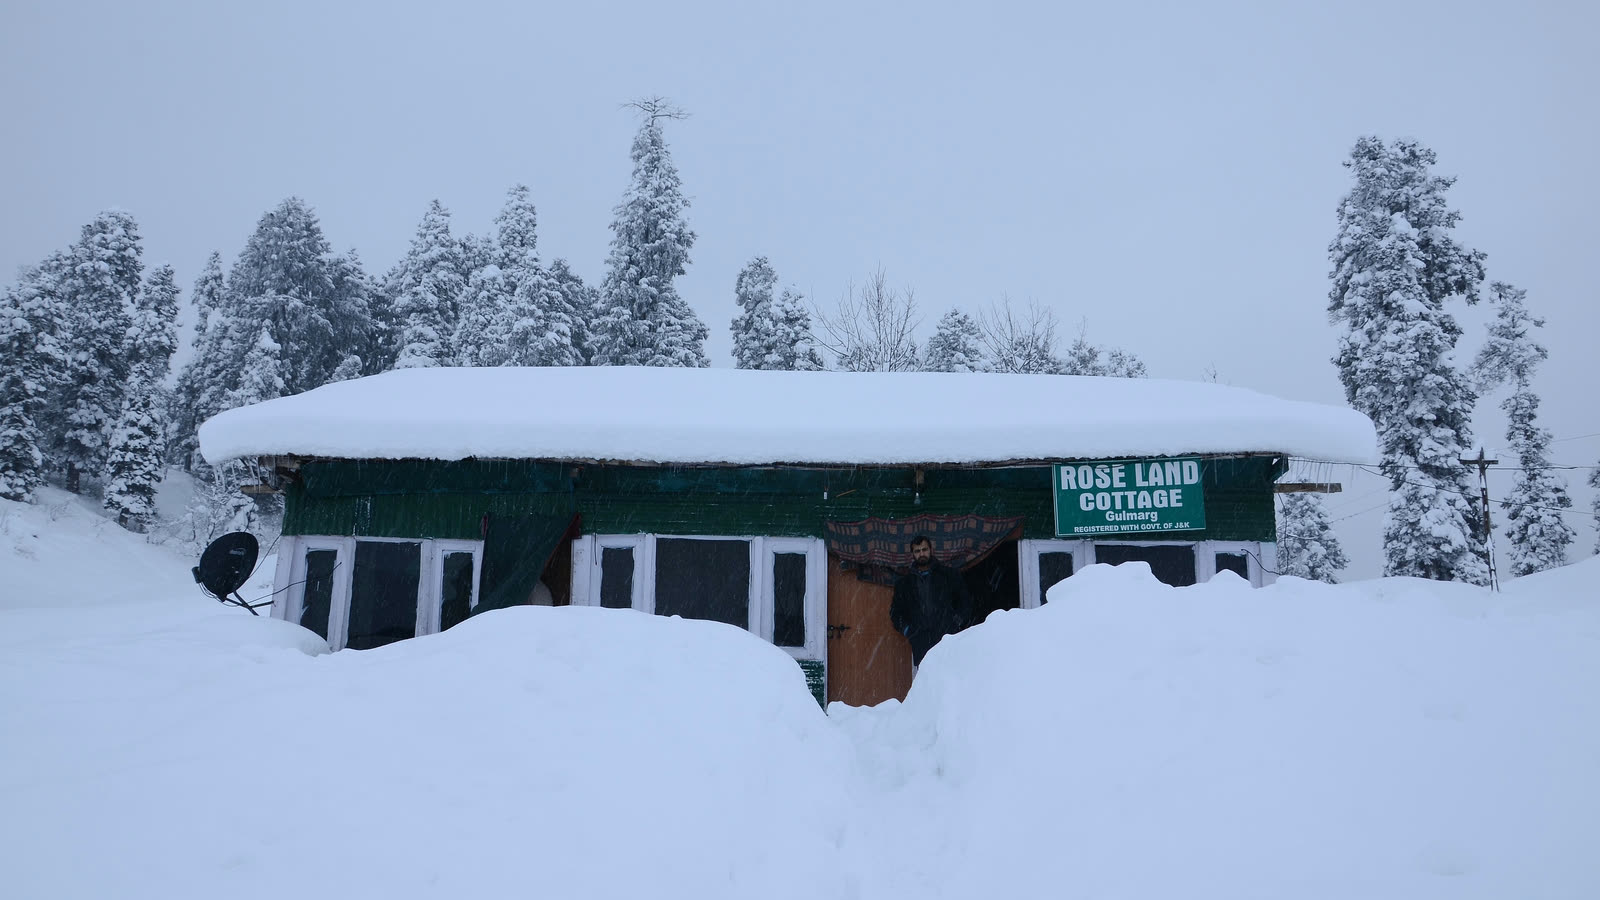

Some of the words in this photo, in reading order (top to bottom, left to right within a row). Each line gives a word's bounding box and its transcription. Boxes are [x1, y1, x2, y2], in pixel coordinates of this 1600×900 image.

[1060, 464, 1126, 490] ROSE
[1135, 461, 1198, 487] LAND
[1079, 489, 1183, 511] COTTAGE
[1105, 510, 1158, 522] Gulmarg
[1074, 525, 1119, 533] REGISTERED
